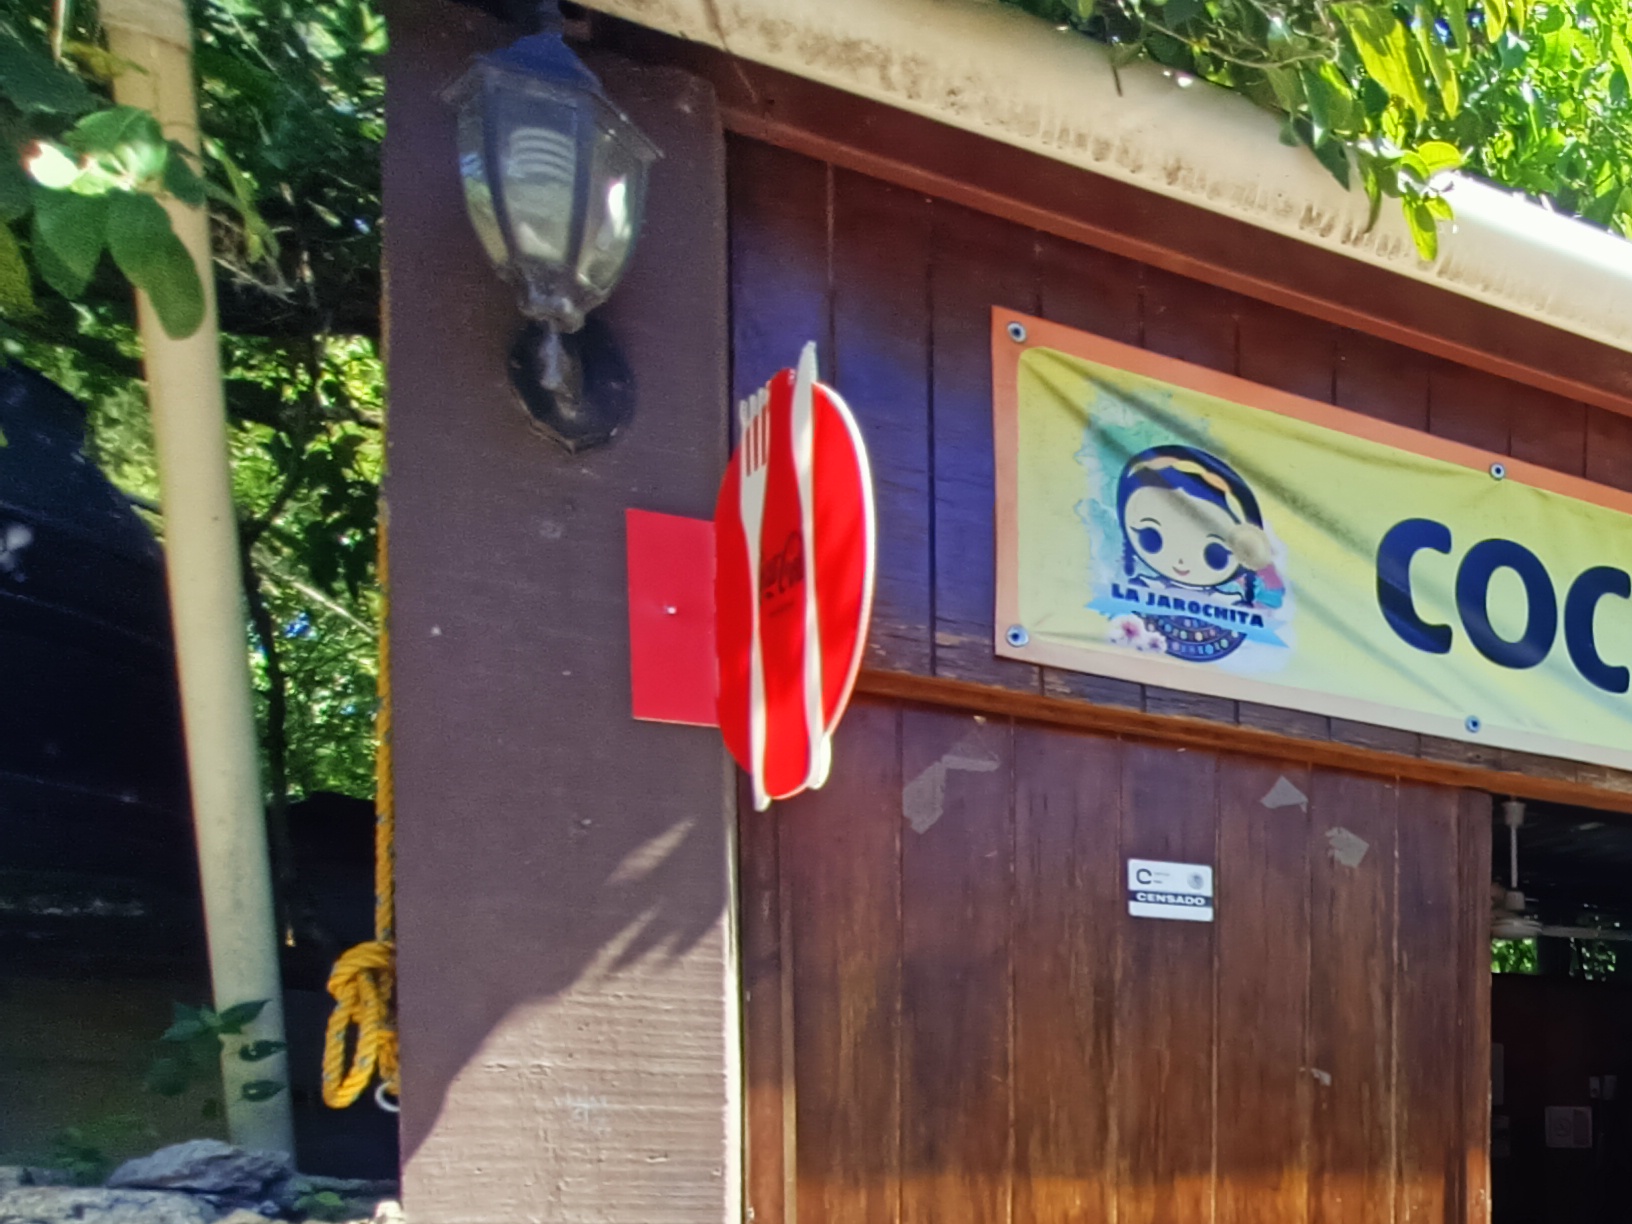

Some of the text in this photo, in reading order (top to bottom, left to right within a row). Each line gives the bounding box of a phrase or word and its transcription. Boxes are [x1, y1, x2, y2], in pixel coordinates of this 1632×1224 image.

[1112, 583, 1264, 628] LA JAROCHITA
[1136, 892, 1206, 906] CENSADO
